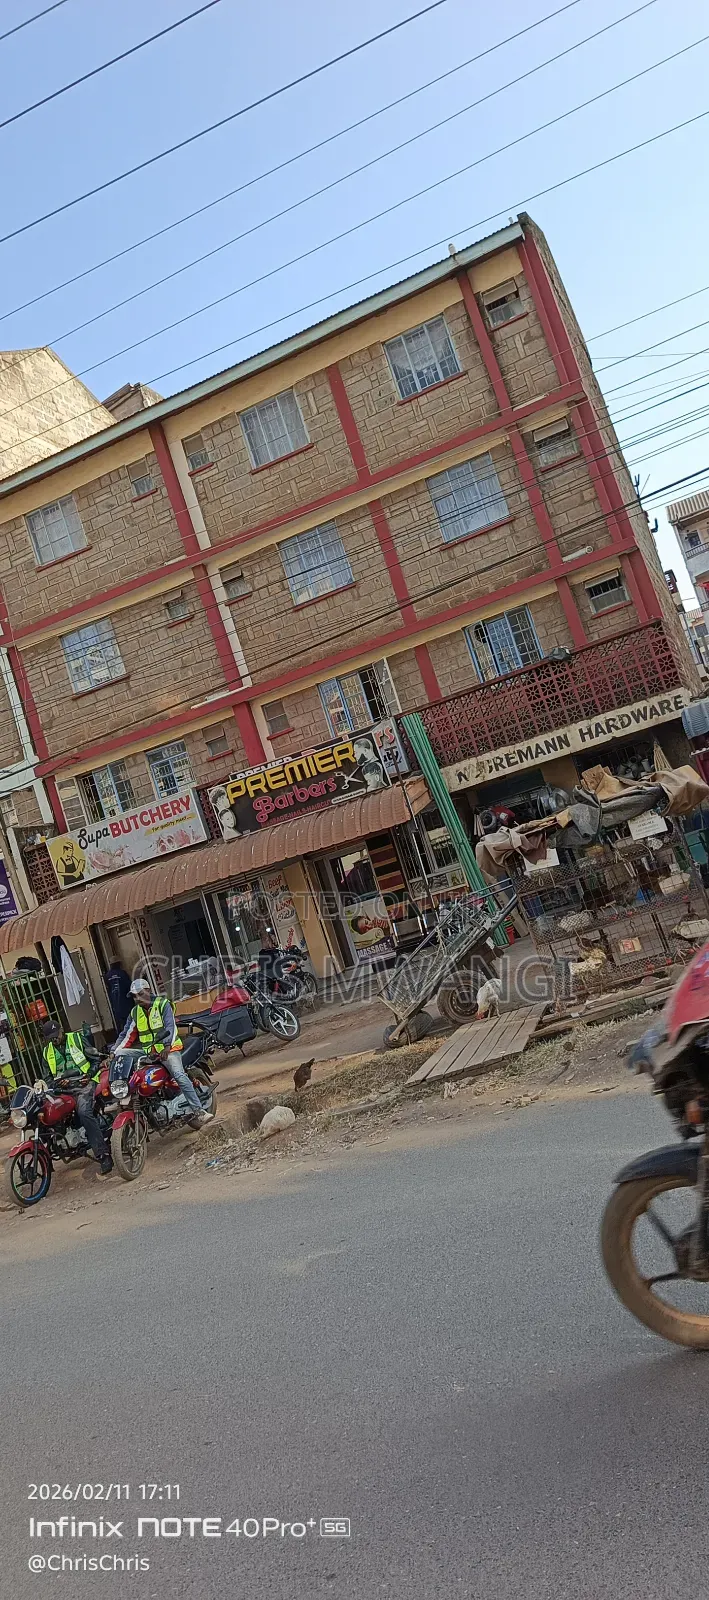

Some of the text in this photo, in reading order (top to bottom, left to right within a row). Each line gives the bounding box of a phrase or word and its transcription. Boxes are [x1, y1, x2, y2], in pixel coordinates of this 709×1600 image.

[226, 741, 357, 805] PREMIER
[77, 794, 191, 851] Supa BUTCHERY
[252, 776, 337, 823] Barbers
[356, 942, 388, 958] MASSAGE
